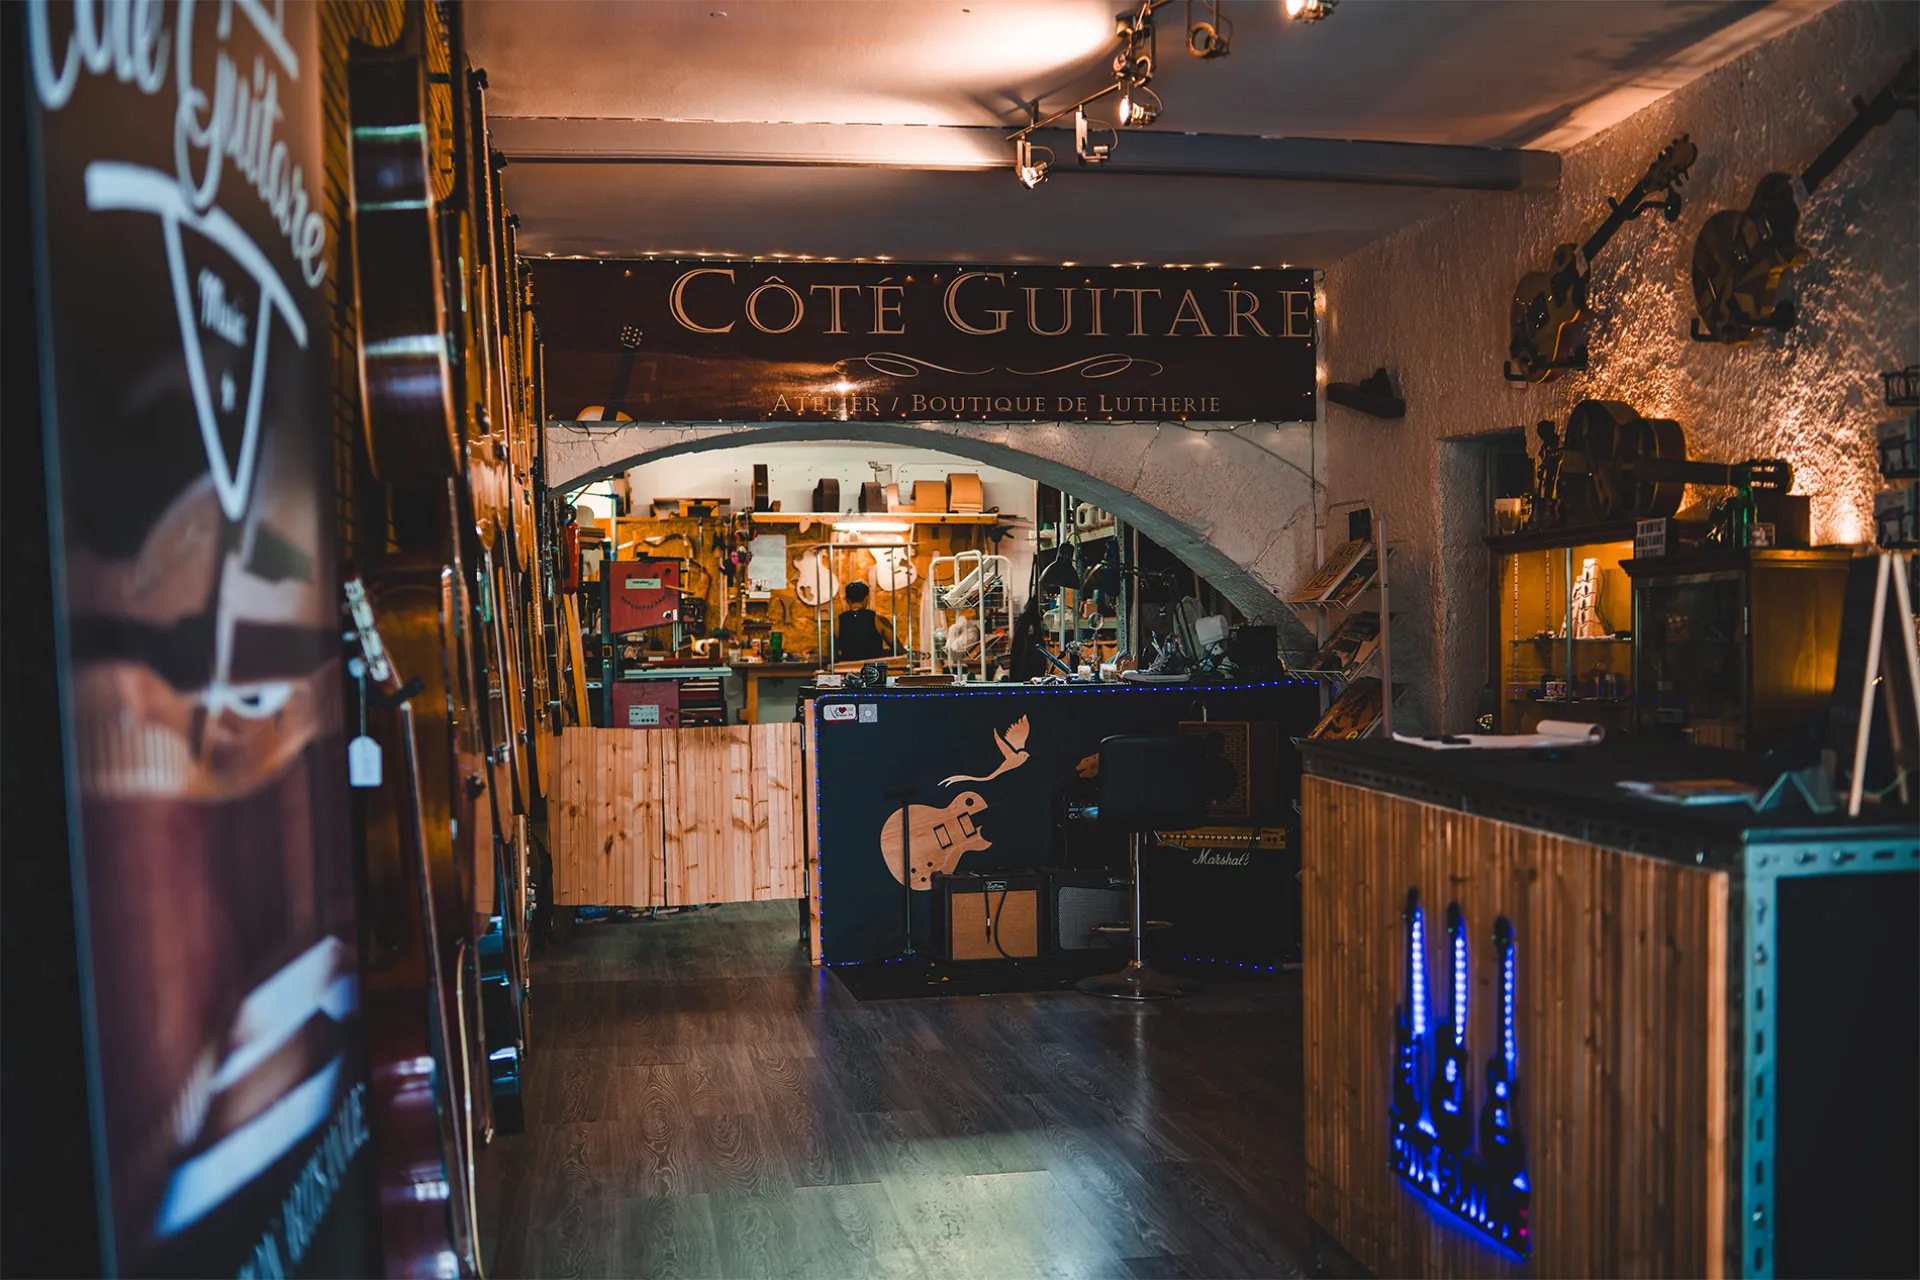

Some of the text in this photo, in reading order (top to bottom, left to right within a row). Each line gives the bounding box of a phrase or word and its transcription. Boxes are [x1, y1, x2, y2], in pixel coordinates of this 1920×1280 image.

[669, 268, 1313, 338] CÔTÉ GUITARE
[773, 394, 879, 412] ATELIER
[911, 394, 1046, 412] BOUTIQUE
[1057, 397, 1087, 412] DE
[1099, 395, 1220, 412] LUTHERIE
[1192, 848, 1250, 866] Marshall
